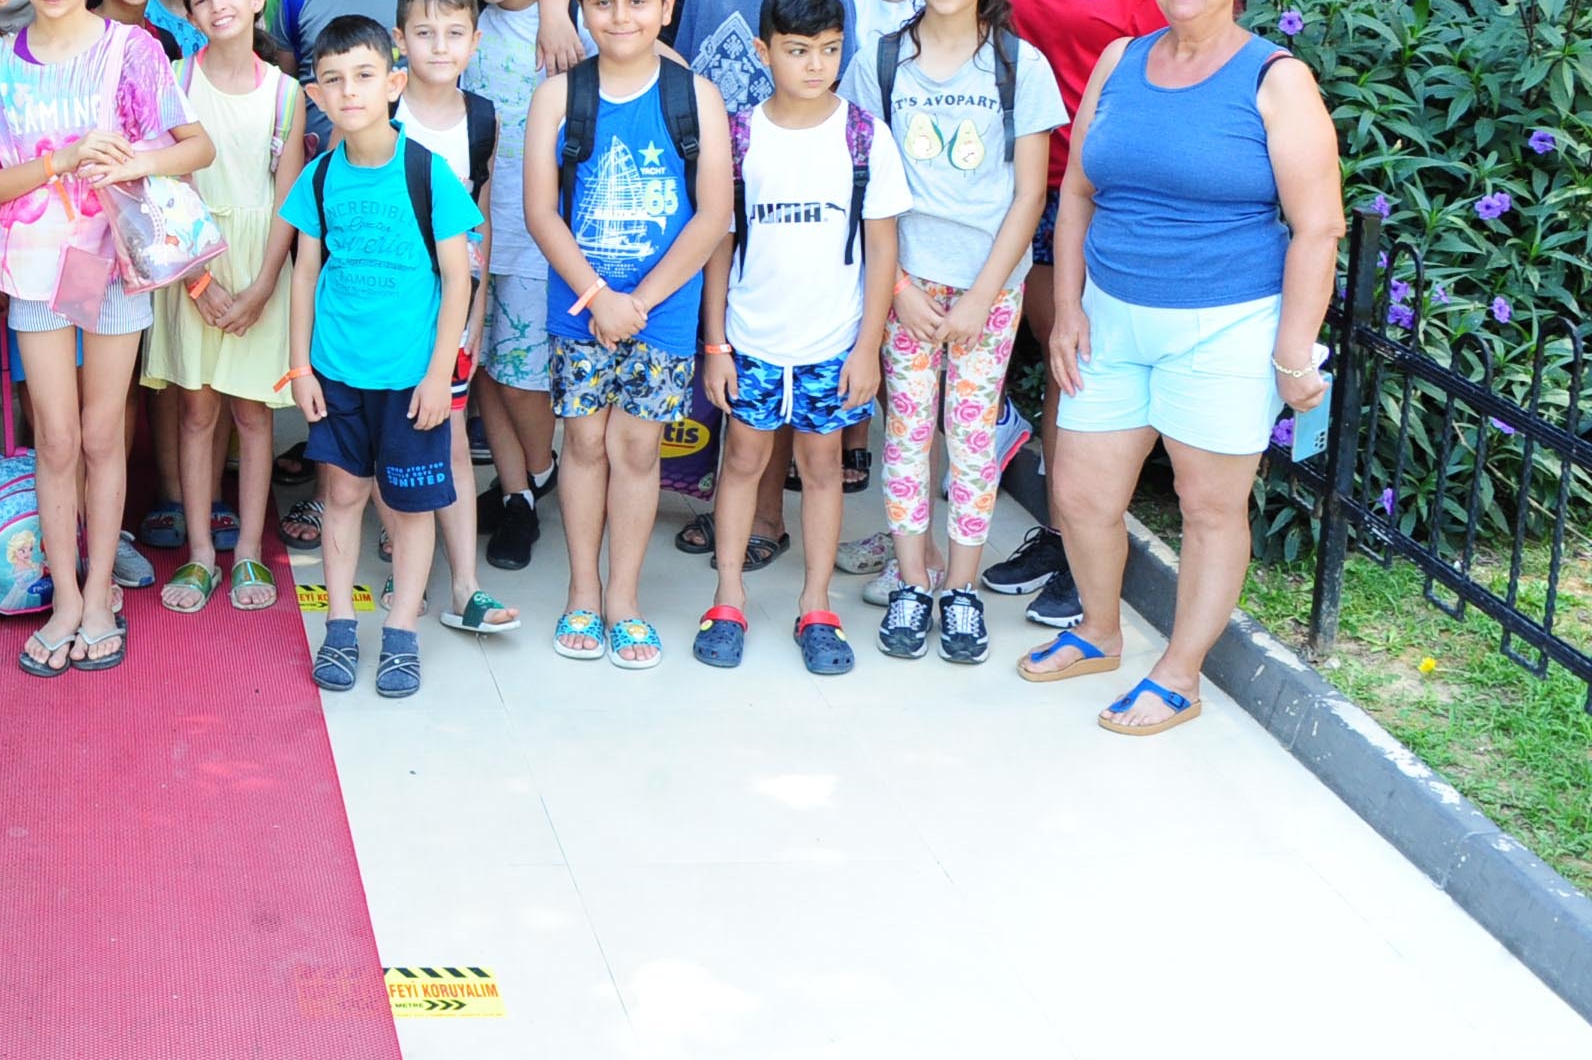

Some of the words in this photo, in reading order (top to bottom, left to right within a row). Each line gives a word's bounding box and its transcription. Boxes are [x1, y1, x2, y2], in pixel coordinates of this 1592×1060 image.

[893, 96, 918, 111] T'S
[640, 167, 666, 175] YACHT
[663, 421, 700, 444] tis
[423, 983, 499, 998] KORUYALIM
